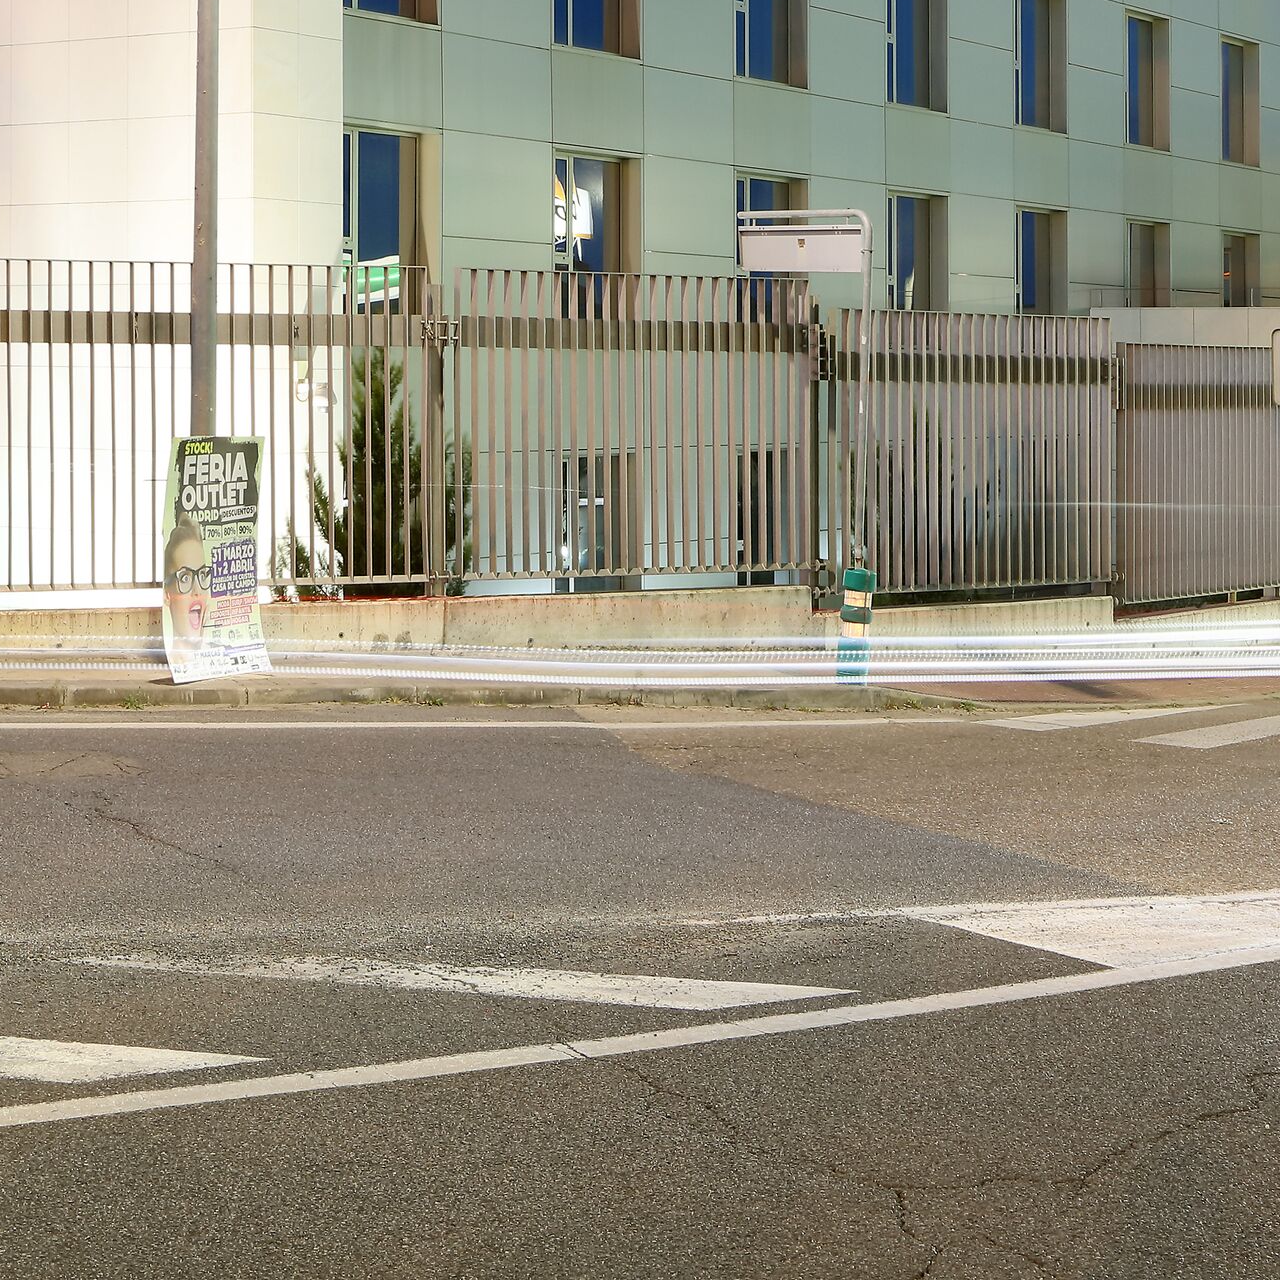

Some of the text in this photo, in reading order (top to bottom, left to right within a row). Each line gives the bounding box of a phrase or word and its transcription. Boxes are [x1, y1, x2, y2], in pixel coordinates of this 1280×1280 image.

[185, 441, 213, 455] STOCK!
[183, 452, 248, 486] FERIA
[181, 481, 248, 511] OUTLET
[207, 525, 253, 538] 70% 80% 90%
[212, 544, 254, 563] 31 MARZO
[212, 563, 217, 577] 1
[222, 561, 229, 575] 2
[230, 558, 255, 574] ABRIL
[212, 583, 227, 593] CASA
[227, 581, 235, 590] DE
[235, 578, 256, 589] CAMPO
